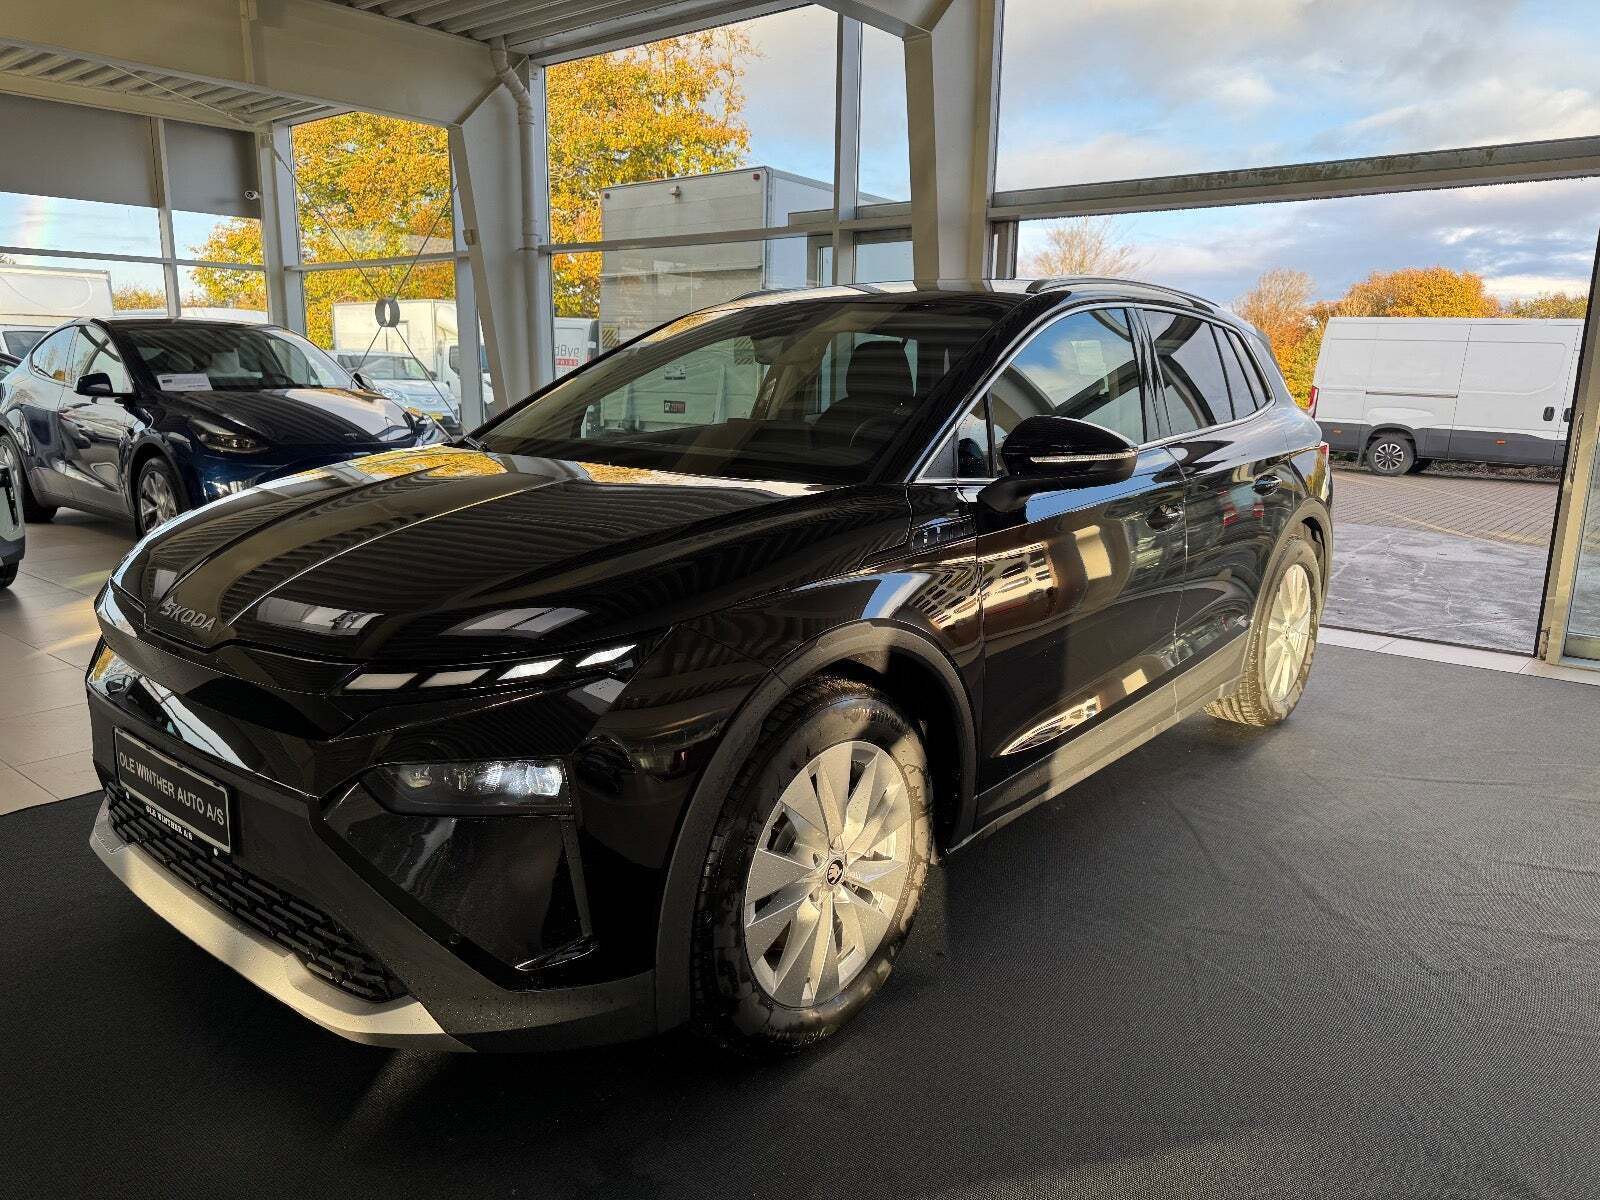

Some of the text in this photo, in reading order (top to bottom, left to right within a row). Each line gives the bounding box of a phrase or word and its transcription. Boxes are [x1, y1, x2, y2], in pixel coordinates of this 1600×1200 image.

[119, 751, 225, 826] OLE WINTHER AUTO A/S
